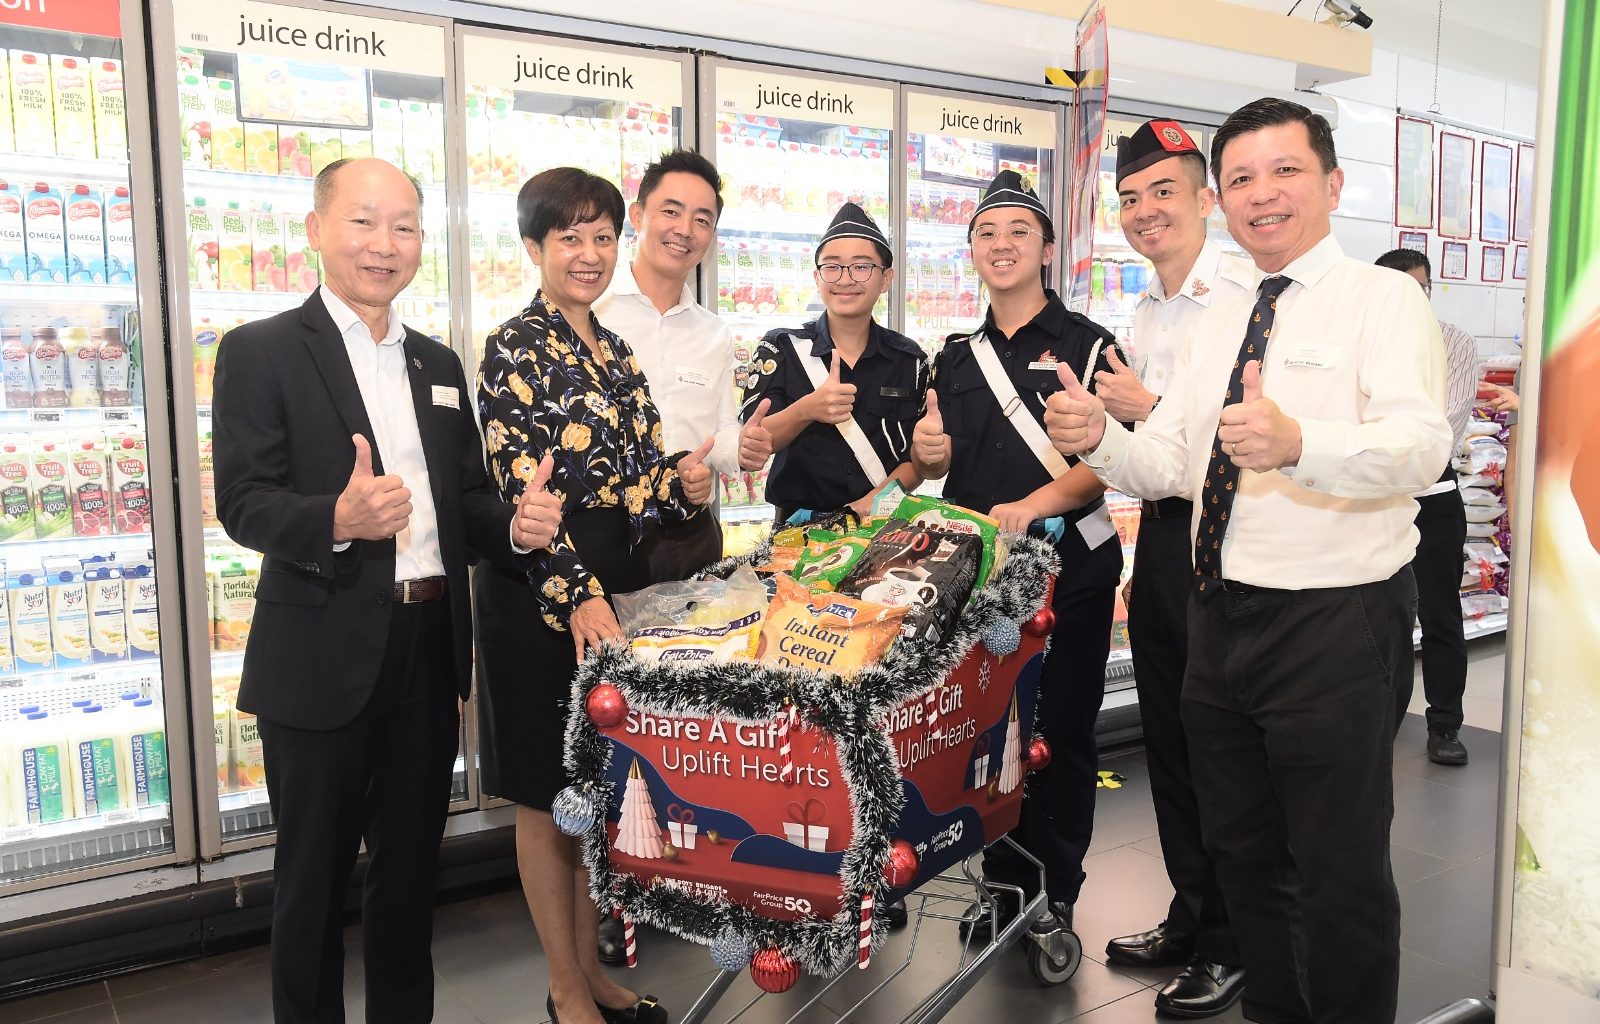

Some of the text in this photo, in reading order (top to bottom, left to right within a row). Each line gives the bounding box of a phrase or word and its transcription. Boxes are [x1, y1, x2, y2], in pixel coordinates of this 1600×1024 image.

[237, 14, 387, 57] juice drink
[513, 53, 635, 91] juice drink
[21, 88, 43, 97] 100%
[61, 92, 83, 100] 100%
[19, 95, 46, 104] FRESH
[60, 99, 86, 107] FRESH
[756, 84, 854, 115] juice drink
[216, 105, 235, 116] Fres
[940, 107, 1023, 135] juice drink
[189, 213, 209, 226] Peel
[223, 215, 241, 228] Peel
[191, 222, 213, 232] Fresh
[225, 224, 247, 234] Fresh
[0, 230, 22, 238] EGA
[29, 231, 62, 240] OMEGA
[109, 235, 135, 243] OMEG
[924, 316, 952, 329] PULL
[2, 465, 23, 473] Fruit
[24, 590, 44, 601] Nutri
[63, 587, 83, 600] Nutri
[101, 583, 120, 596] Nutri
[223, 590, 256, 601] Natural
[784, 617, 850, 648] Instant
[779, 636, 837, 666] Cereal
[939, 683, 963, 715] Gift
[625, 709, 779, 749] Share A Gif
[900, 716, 976, 772] Uplift Hearts
[133, 736, 146, 793] FARMHOUSE
[154, 750, 162, 768] MILK
[662, 745, 733, 778] Uplift
[81, 743, 96, 801] FARMHOUSE
[103, 757, 113, 775] MILK
[24, 750, 39, 809] FARMHOUSE
[48, 764, 57, 782] MILK
[947, 819, 963, 846] 50
[753, 891, 812, 914] FairPrice 50
[760, 899, 783, 909] Group
